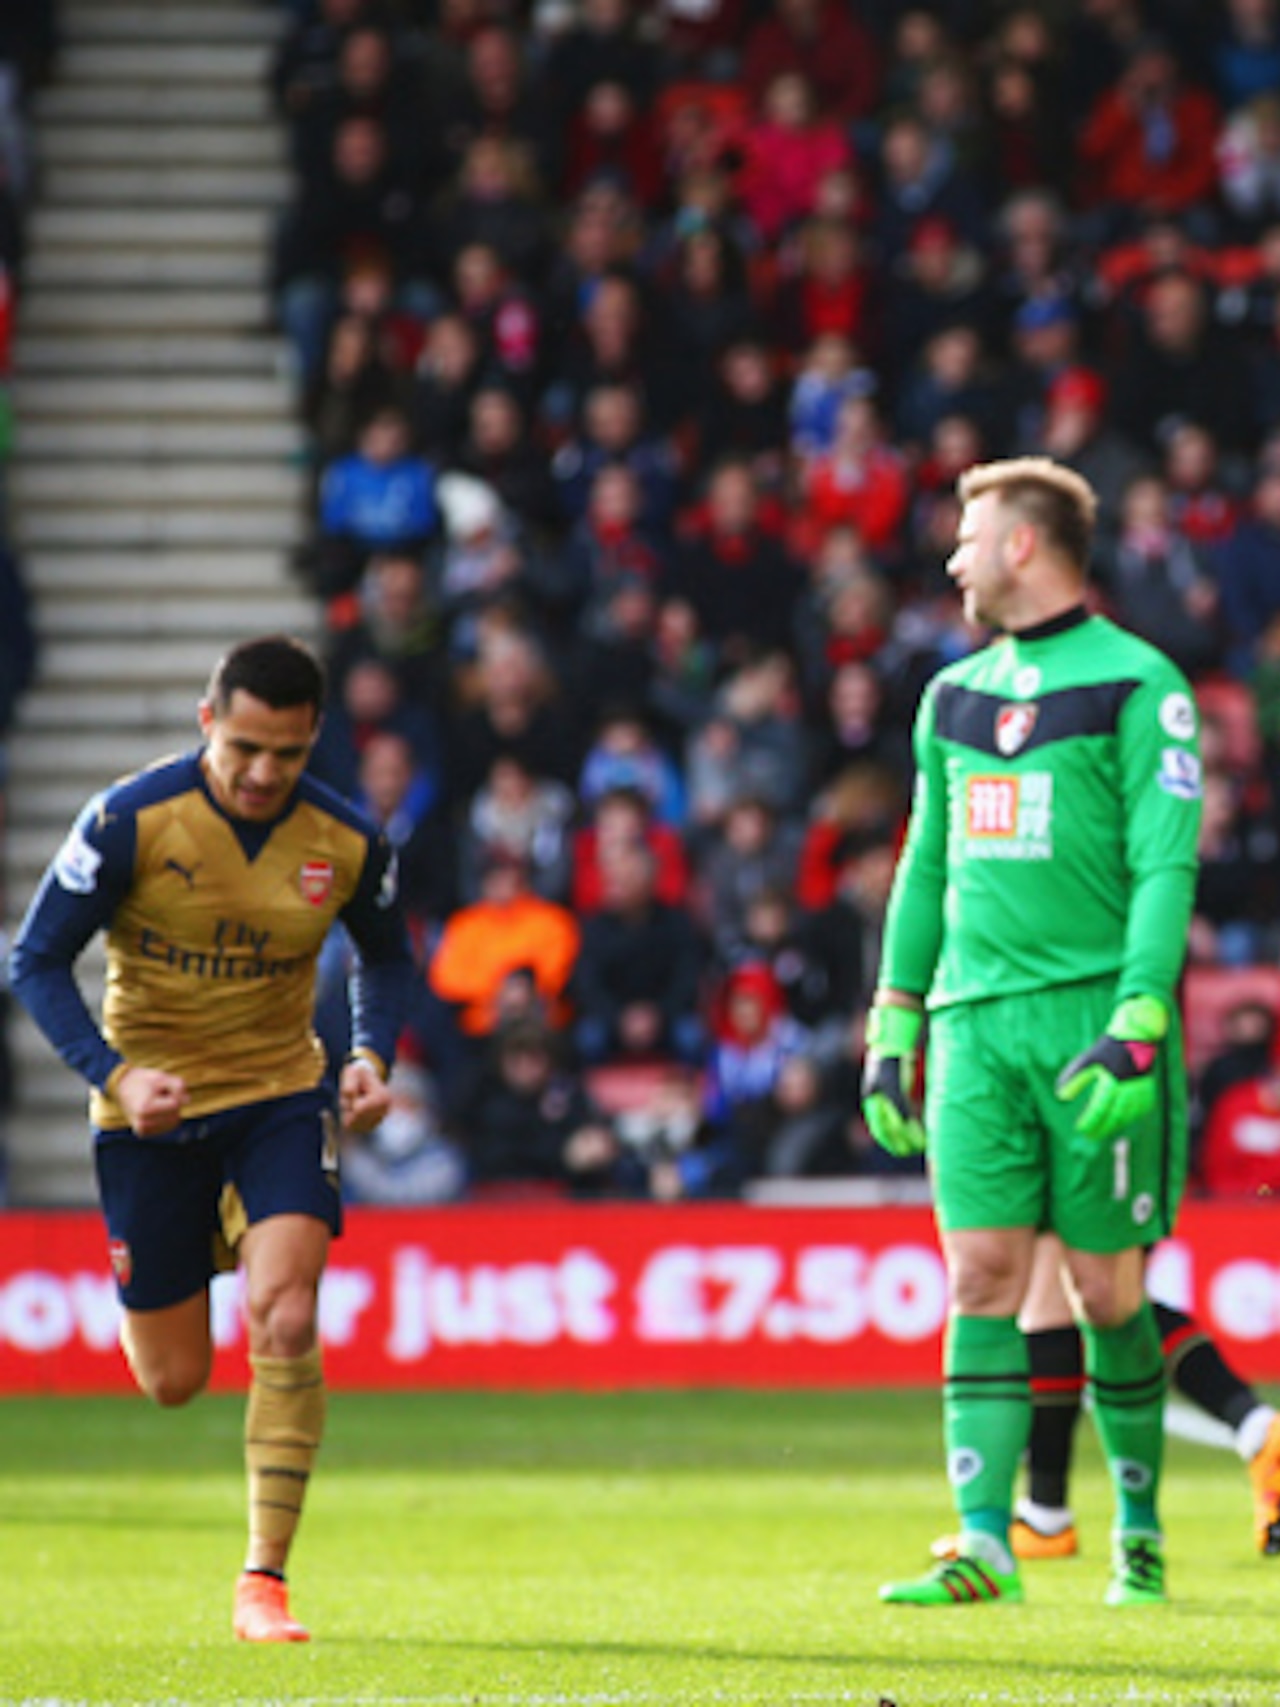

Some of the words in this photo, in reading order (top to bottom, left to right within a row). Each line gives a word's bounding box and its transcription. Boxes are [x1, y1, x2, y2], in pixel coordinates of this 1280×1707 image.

[214, 918, 271, 955] Fly
[1113, 1138, 1128, 1201] 1
[386, 1245, 616, 1362] just
[635, 1244, 947, 1341] £7.50
